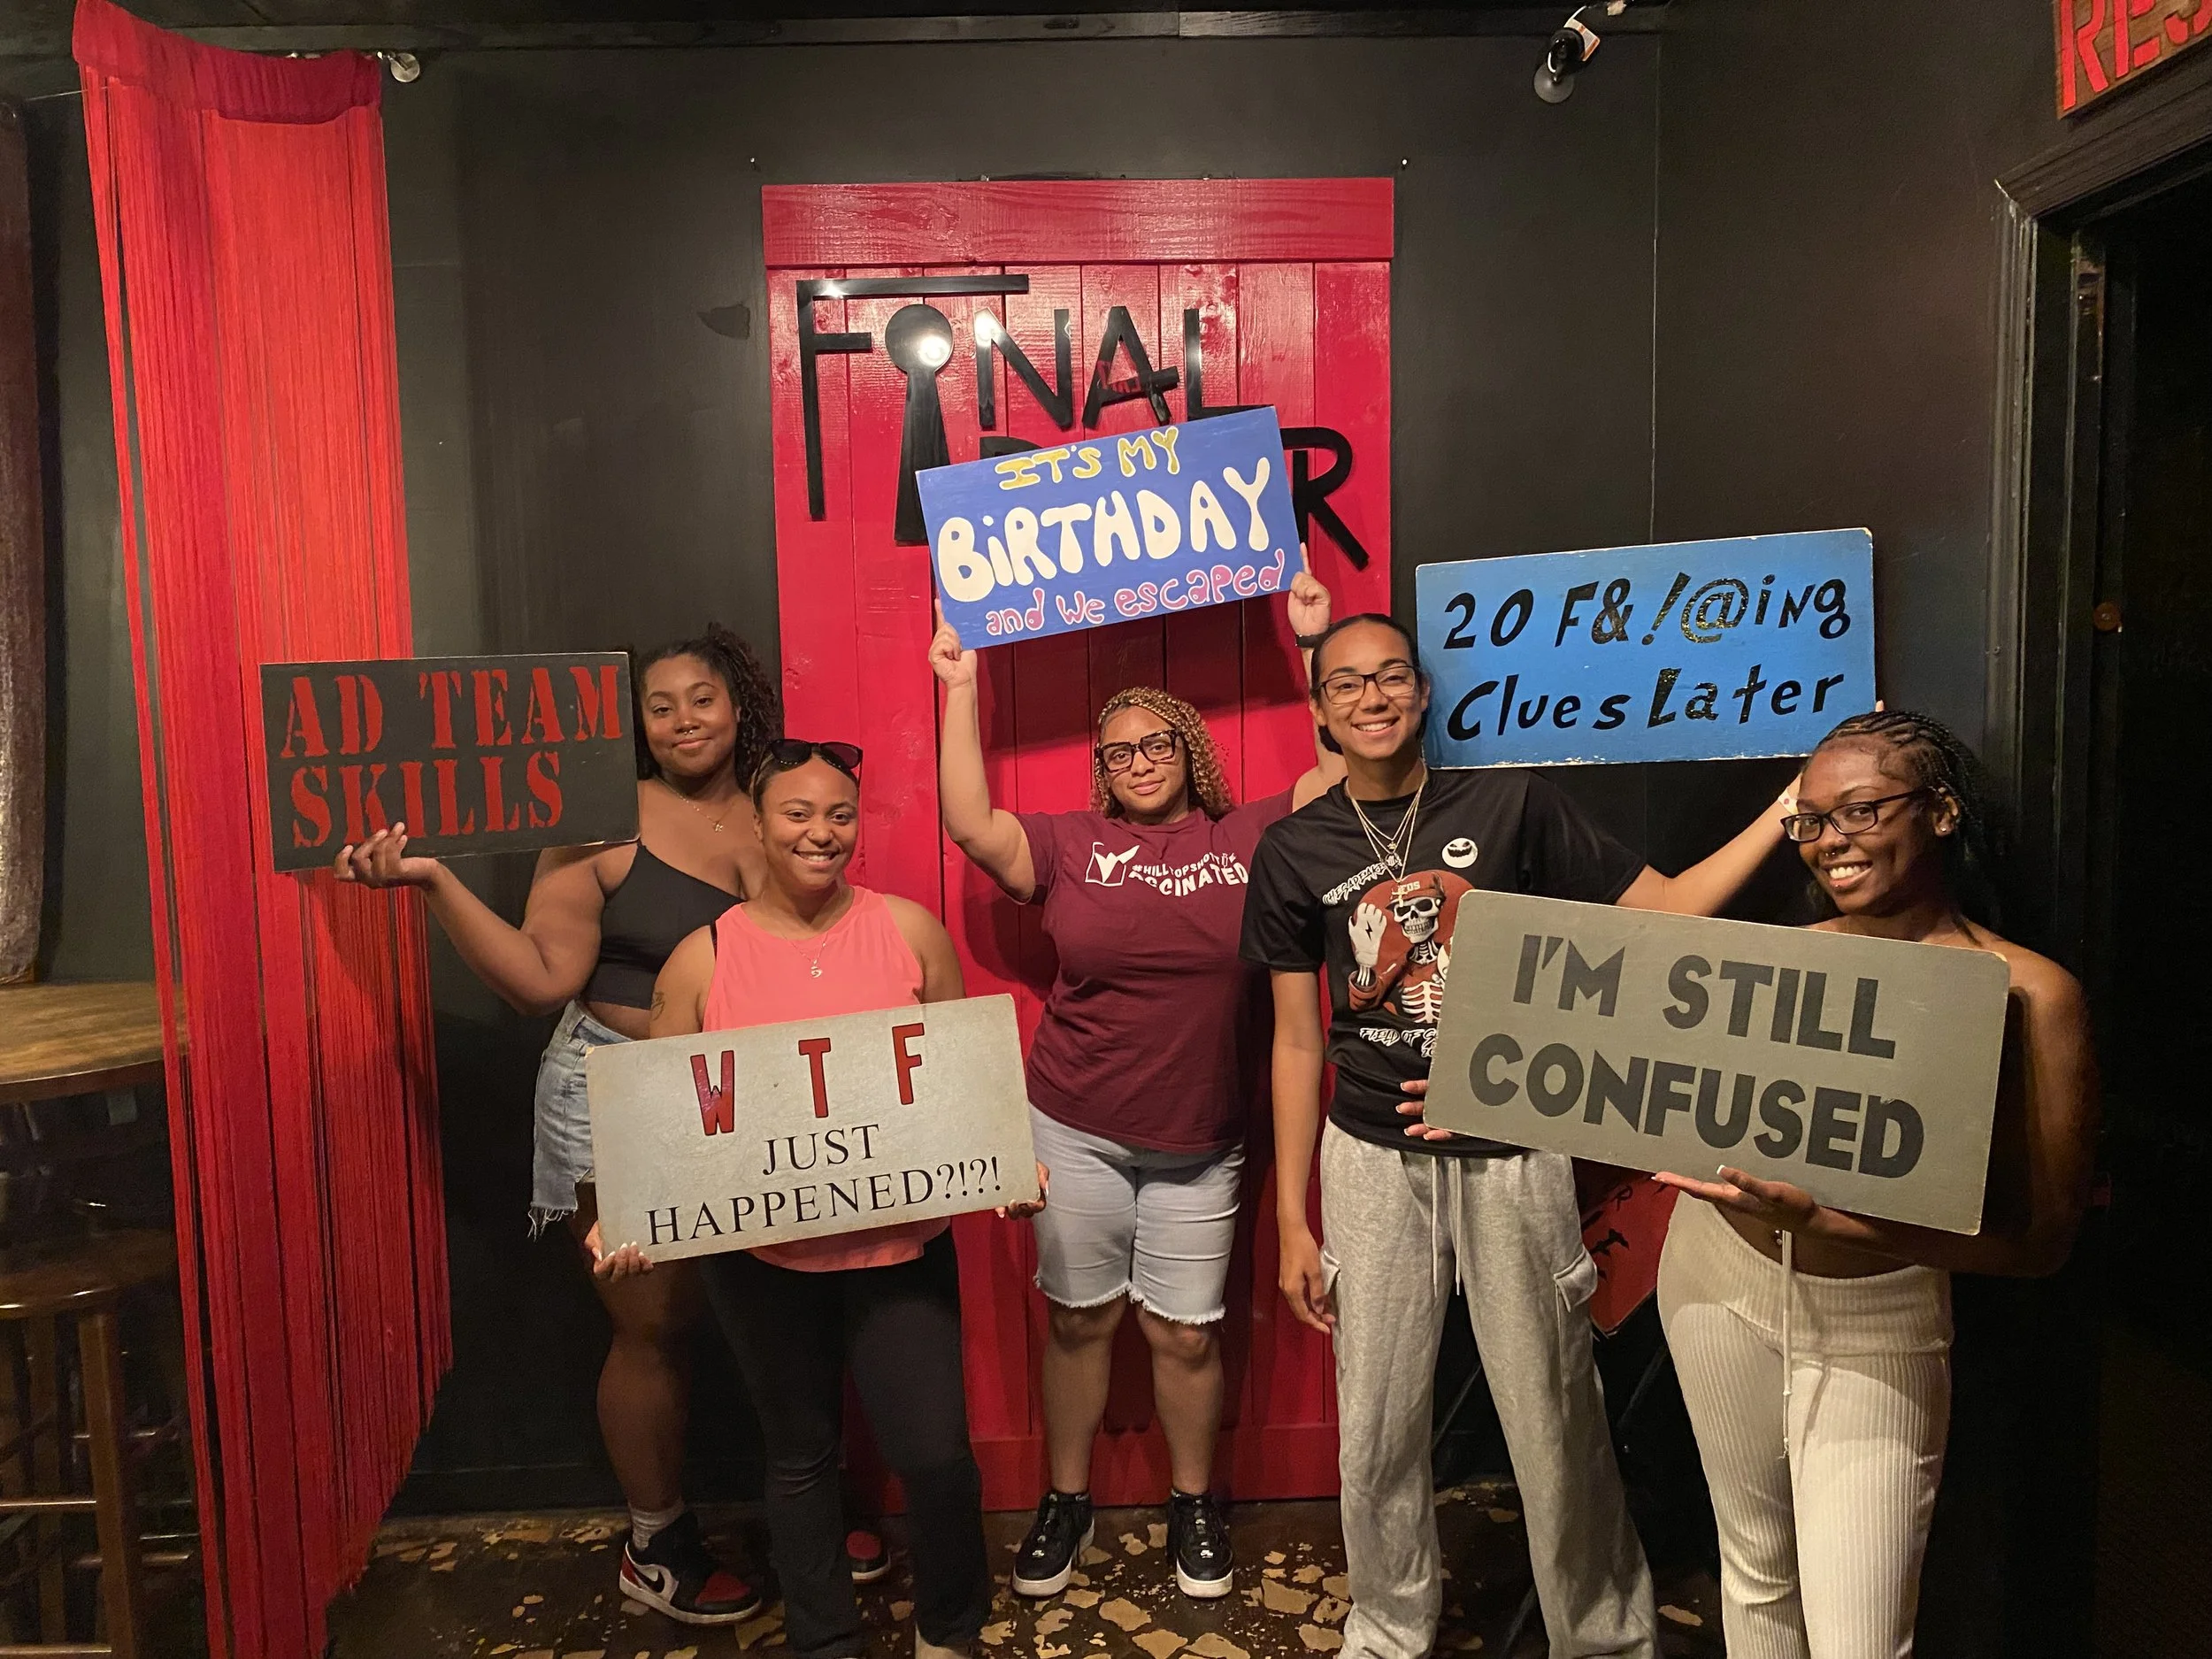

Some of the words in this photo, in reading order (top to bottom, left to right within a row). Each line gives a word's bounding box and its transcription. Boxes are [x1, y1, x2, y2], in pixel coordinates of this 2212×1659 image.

[995, 445, 1102, 490] IT'S
[1118, 426, 1180, 477] MY
[986, 588, 1045, 636] and
[1443, 588, 1534, 649] 20
[280, 675, 384, 758] AD
[419, 664, 624, 750] TEAM
[1447, 674, 1631, 741] Clues
[1647, 664, 1845, 729] Later
[290, 751, 564, 849] SKILLS
[1512, 933, 1625, 1018] I'M
[1662, 954, 1896, 1060] STILL
[1468, 1033, 1925, 1179] CONFUSED
[763, 1124, 879, 1176] JUST
[644, 1156, 1002, 1246] HAPPENED?!?!
